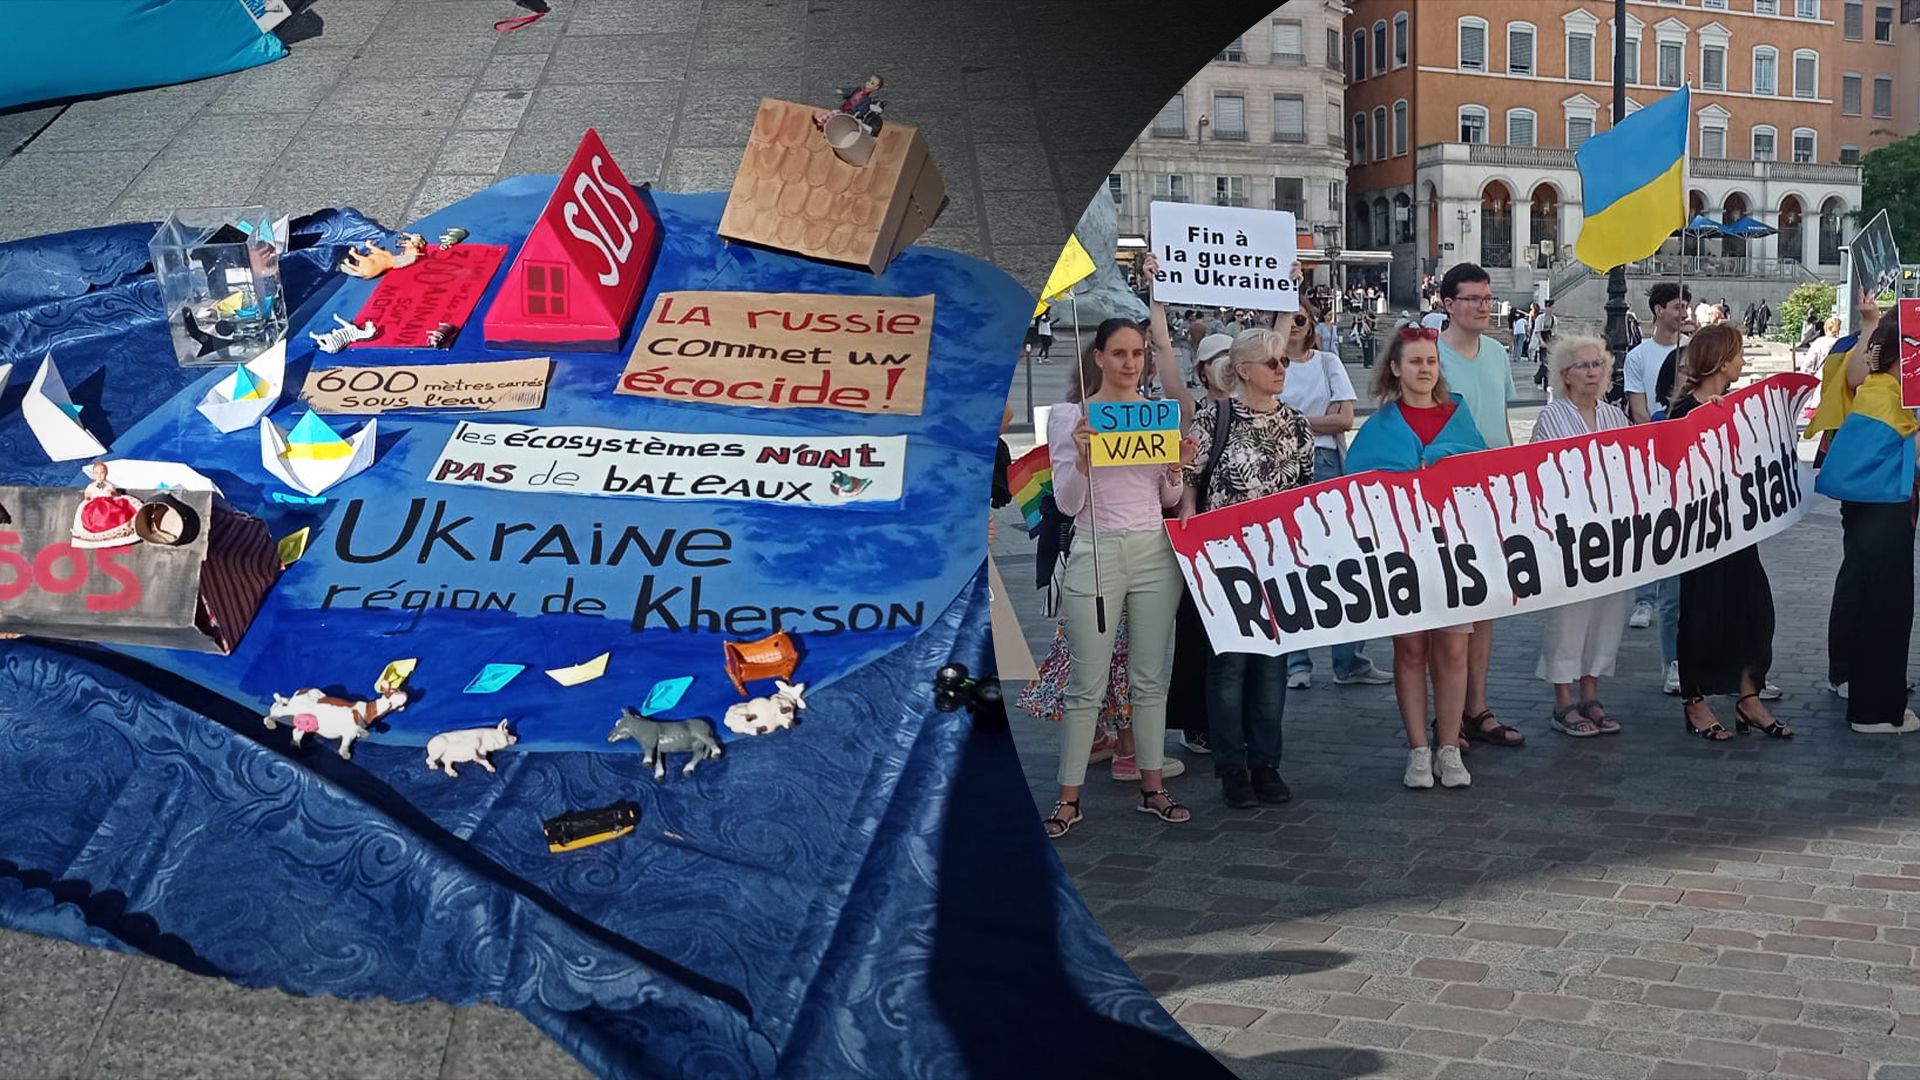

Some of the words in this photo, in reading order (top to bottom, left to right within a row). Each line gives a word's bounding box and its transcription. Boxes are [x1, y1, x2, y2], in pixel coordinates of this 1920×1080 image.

[563, 154, 639, 286] SOS
[1188, 226, 1224, 245] Fin
[1235, 230, 1248, 247] à
[1165, 245, 1187, 262] la
[1198, 251, 1277, 269] guerre
[1154, 270, 1183, 283] en
[1194, 268, 1298, 291] Ukraine!
[390, 297, 412, 325] SONT
[394, 286, 447, 344] ANIMAUX
[656, 297, 711, 327] LA
[747, 309, 921, 334] russie
[647, 338, 832, 364] commet
[316, 369, 419, 393] 600
[424, 378, 494, 392] mètres
[497, 378, 544, 389] carrés
[340, 396, 409, 407] sous
[424, 394, 496, 407] l'eau
[1101, 403, 1170, 430] STOP
[455, 423, 496, 445] les
[504, 427, 745, 457] écosystèmes
[1102, 433, 1166, 460] WAR
[435, 458, 517, 483] PAS
[528, 459, 580, 486] de
[1214, 536, 1422, 640] Russia
[1432, 526, 1488, 608] is
[1503, 534, 1542, 599] a
[1555, 473, 1732, 587] terrorist
[541, 577, 607, 618] de
